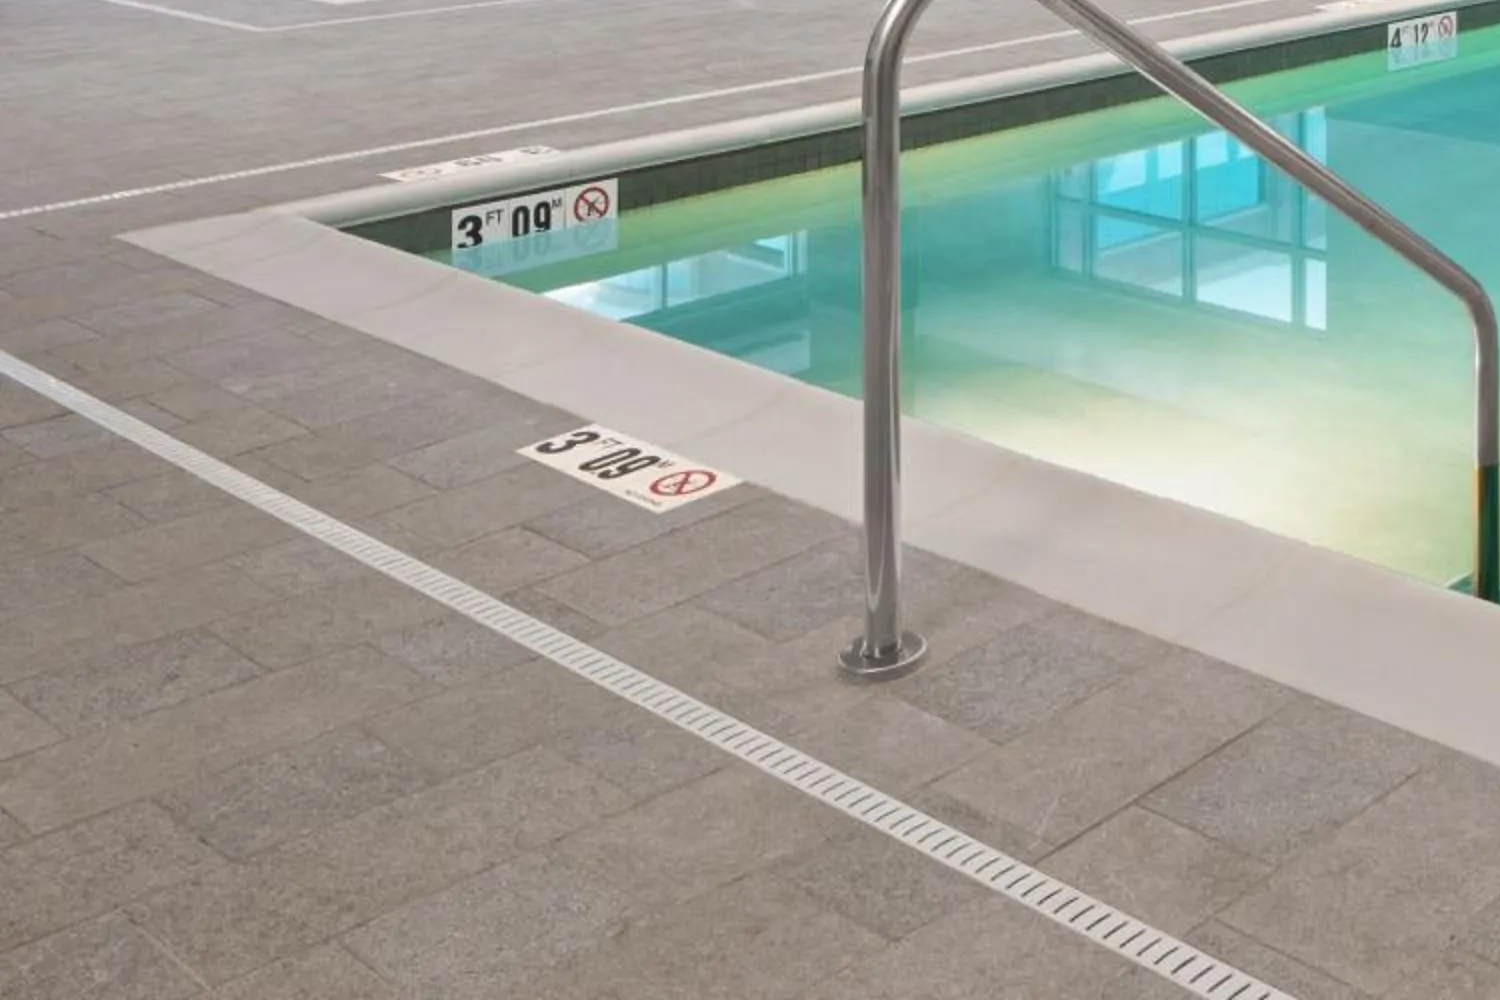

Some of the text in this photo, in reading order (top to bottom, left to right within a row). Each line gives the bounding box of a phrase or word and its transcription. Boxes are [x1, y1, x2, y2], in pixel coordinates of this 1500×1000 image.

[1391, 27, 1402, 48] 4
[457, 215, 482, 249] 3
[486, 209, 504, 226] FT
[536, 431, 600, 454] 3
